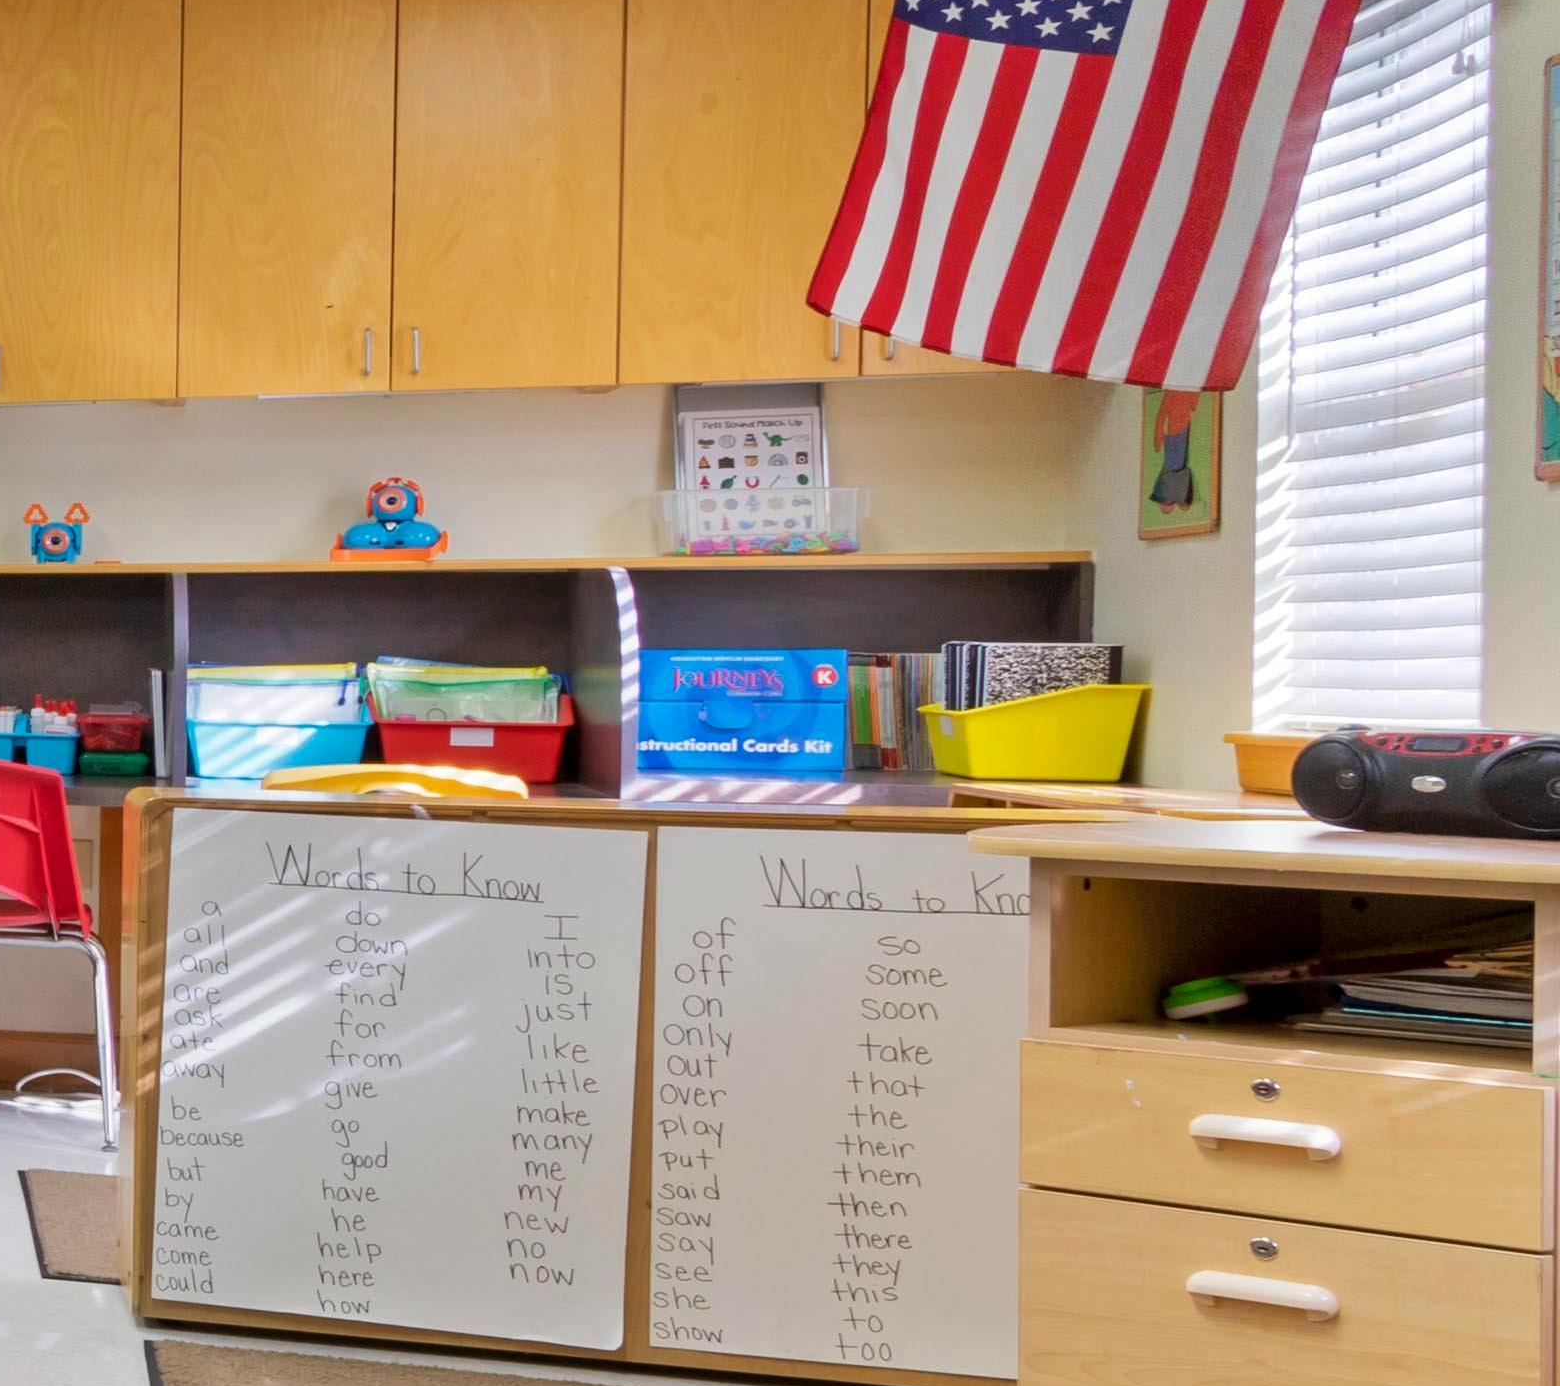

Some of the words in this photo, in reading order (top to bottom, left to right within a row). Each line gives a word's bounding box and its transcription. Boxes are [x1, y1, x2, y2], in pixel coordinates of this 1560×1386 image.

[787, 419, 803, 427] Up
[673, 666, 784, 693] JOURNEYS
[817, 671, 833, 684] K
[636, 738, 738, 753] structional
[743, 739, 799, 754] Cards
[805, 740, 833, 754] Kit
[266, 842, 380, 890] Words
[402, 863, 436, 895] to
[463, 852, 542, 901] Know
[760, 854, 883, 911] Words
[915, 889, 945, 913] to
[971, 871, 1030, 914] Kno
[201, 900, 222, 918] a
[345, 900, 382, 928] do
[183, 924, 226, 947] all
[543, 914, 580, 941] I
[692, 916, 736, 950] of
[335, 932, 409, 957] down
[526, 945, 597, 970] into
[179, 951, 230, 976] and
[323, 956, 407, 992] every
[673, 952, 734, 988] off
[173, 983, 221, 1005] are
[333, 982, 398, 1009] find
[544, 971, 575, 997] is
[173, 1008, 224, 1030] ask
[333, 1009, 386, 1039] for
[514, 990, 594, 1034] just
[169, 1032, 214, 1053] ate
[325, 1040, 402, 1070] from
[526, 1033, 589, 1064] like
[857, 1032, 934, 1065] take
[160, 1059, 226, 1090] away
[522, 1068, 601, 1095] little
[846, 1071, 927, 1098] that
[324, 1077, 379, 1111] give
[171, 1099, 203, 1122] be
[515, 1104, 592, 1128] make
[847, 1103, 908, 1130] the
[160, 1127, 245, 1148] because
[330, 1116, 361, 1148] go
[657, 1114, 724, 1149] play
[511, 1130, 593, 1165] many
[835, 1133, 916, 1159] their
[166, 1157, 206, 1182] but
[341, 1141, 389, 1182] good
[525, 1159, 567, 1182] me
[658, 1147, 714, 1172] put
[832, 1162, 922, 1188] them
[321, 1178, 380, 1203] have
[517, 1184, 564, 1213] my
[164, 1188, 195, 1223] by
[826, 1192, 908, 1218] then
[155, 1219, 220, 1242] came
[330, 1207, 368, 1233] he
[503, 1210, 570, 1235] new
[317, 1231, 383, 1264] help
[505, 1237, 546, 1260] no
[833, 1223, 913, 1250] there
[155, 1244, 213, 1268] come
[155, 1268, 214, 1295] could
[318, 1265, 375, 1288] here
[509, 1261, 575, 1287] now
[832, 1253, 901, 1286] they
[316, 1289, 371, 1315] how
[830, 1278, 899, 1303] this
[842, 1305, 884, 1333] to
[835, 1332, 893, 1362] too
